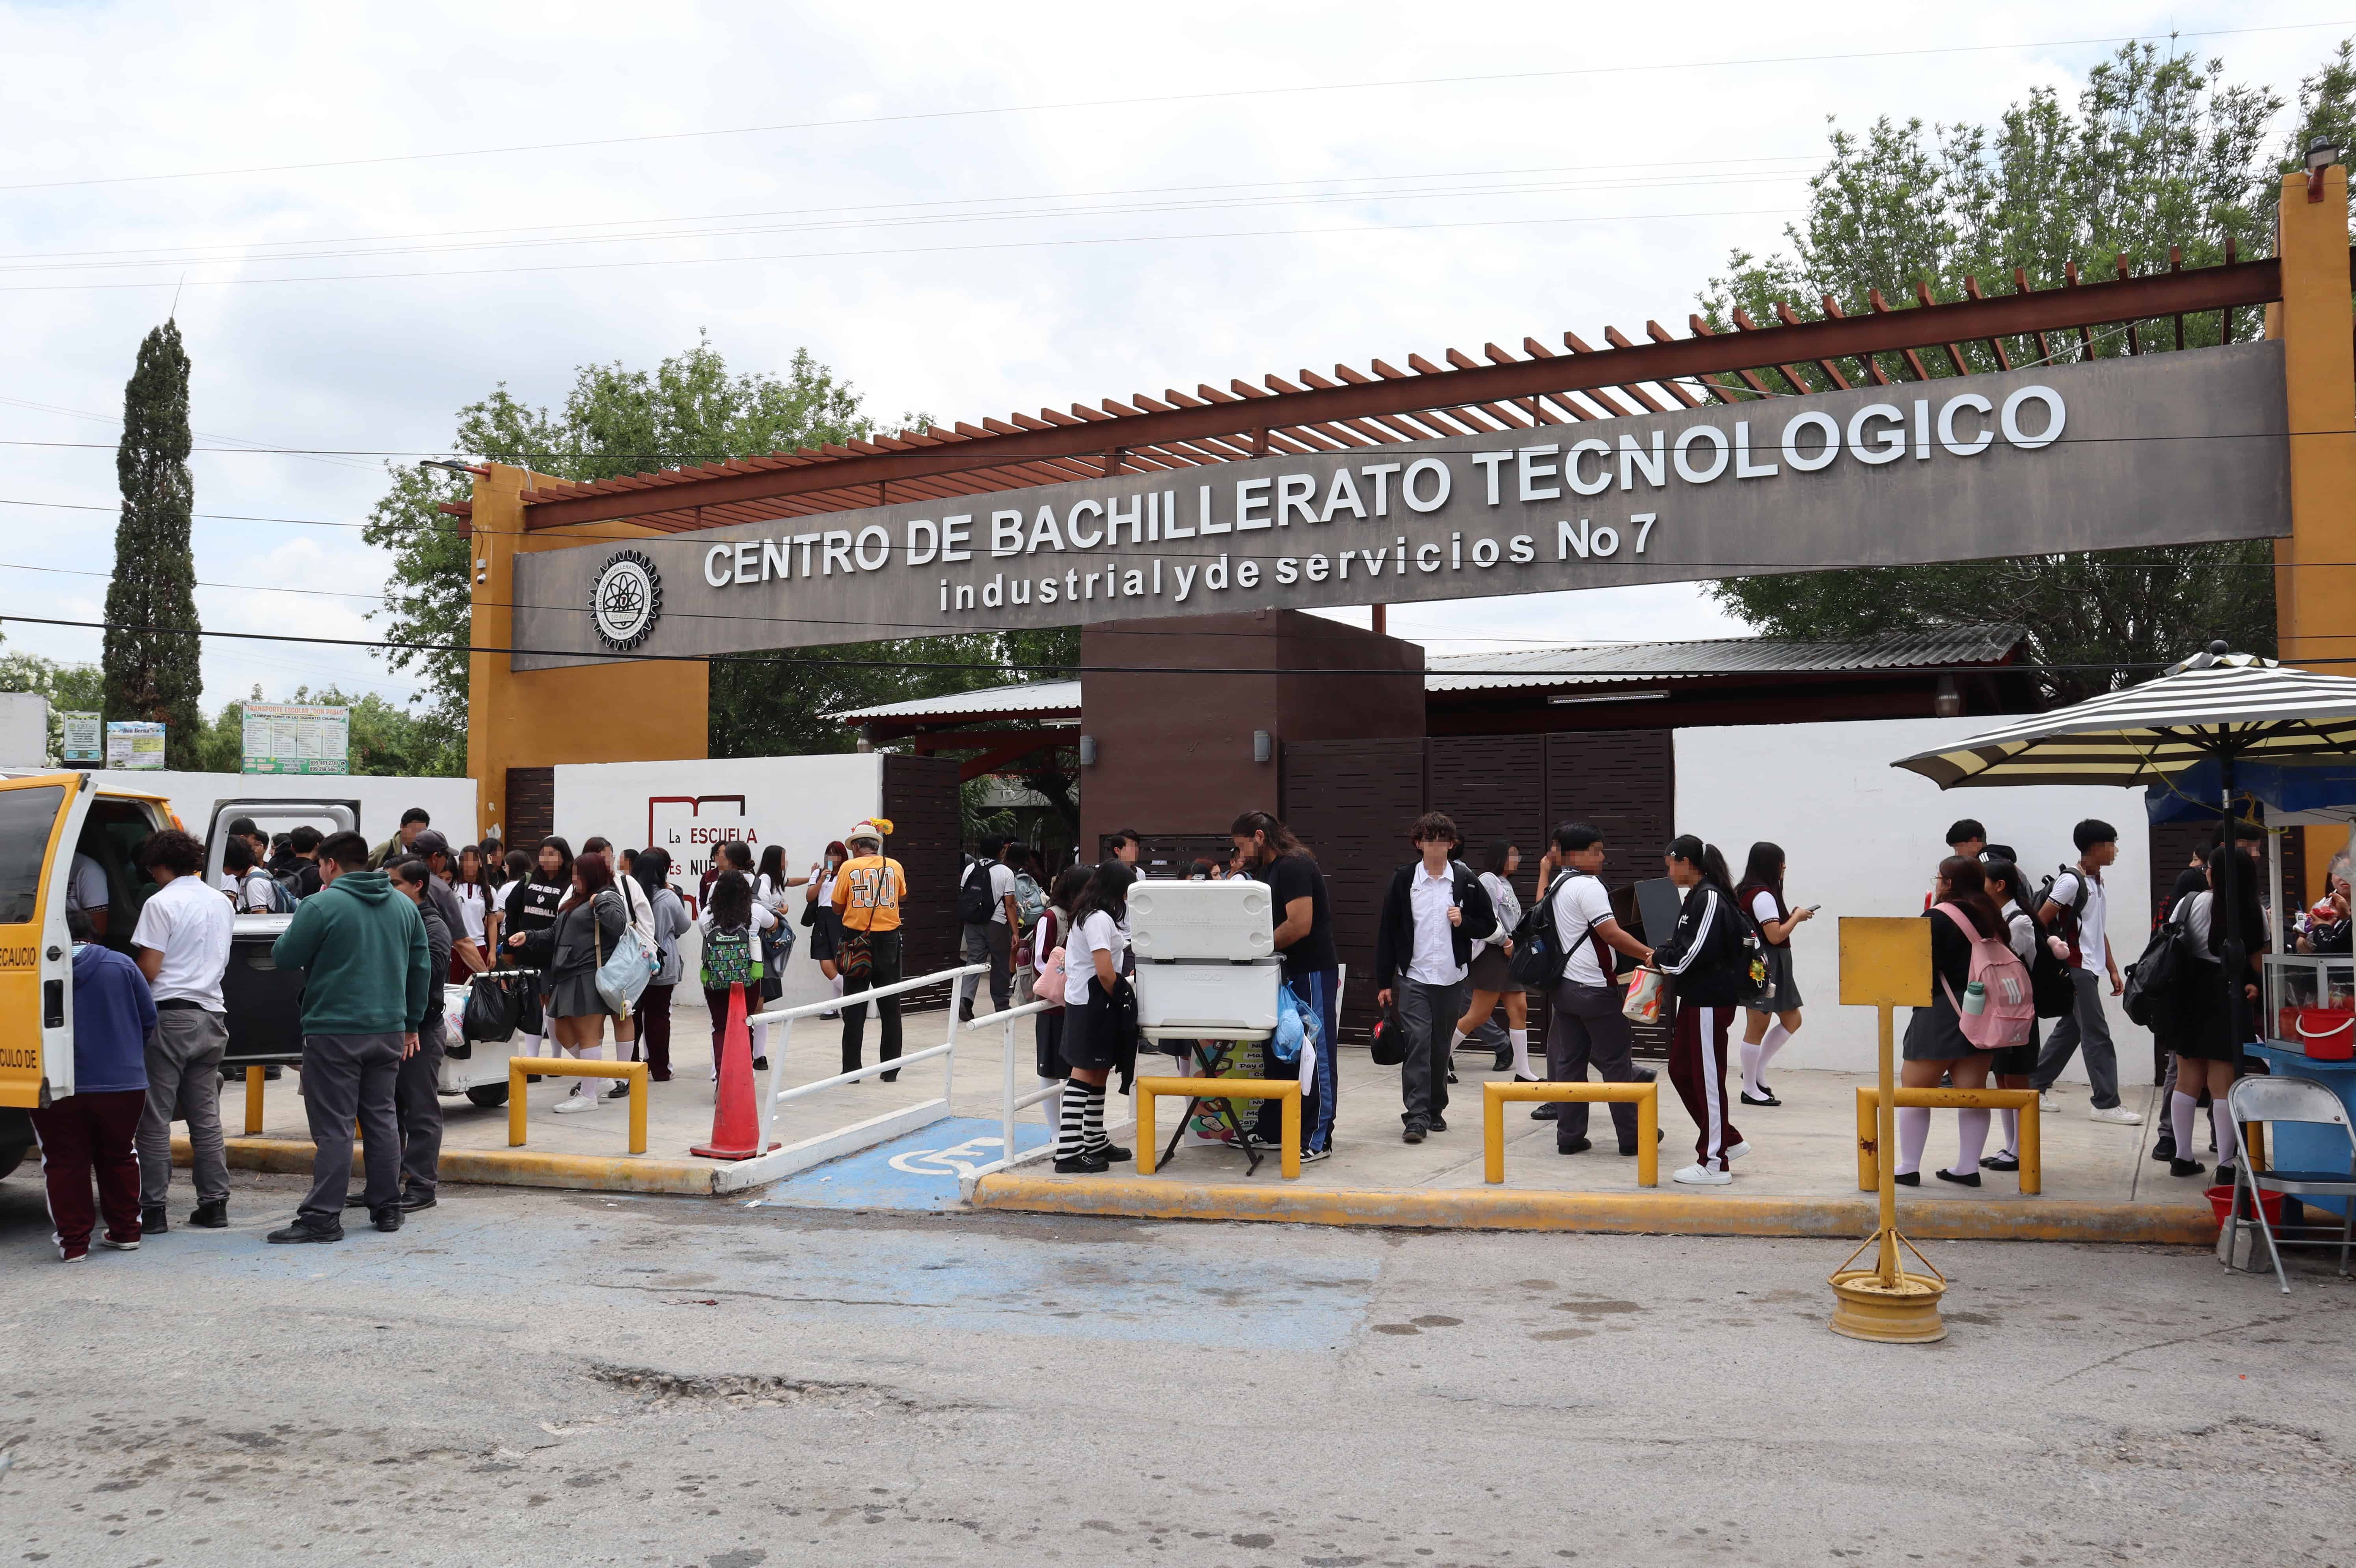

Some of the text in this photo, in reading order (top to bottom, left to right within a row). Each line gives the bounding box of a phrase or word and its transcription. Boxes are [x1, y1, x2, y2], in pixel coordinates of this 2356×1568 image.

[704, 385, 2066, 587] CENTRO DE BACHILLERATO TECNOLOGICO
[1276, 532, 1535, 584] servicios
[1558, 519, 1619, 560] No
[1630, 513, 1656, 553] 7
[602, 581, 606, 589] DE
[605, 564, 637, 581] BACHILLERATO
[637, 568, 651, 608] TECNOLOGICO
[620, 596, 627, 605] 7
[669, 828, 681, 844] La
[849, 867, 895, 908] 100
[523, 905, 555, 918] BASEBALL
[1183, 973, 1224, 981] IGLOO
[24, 1050, 37, 1069] DE
